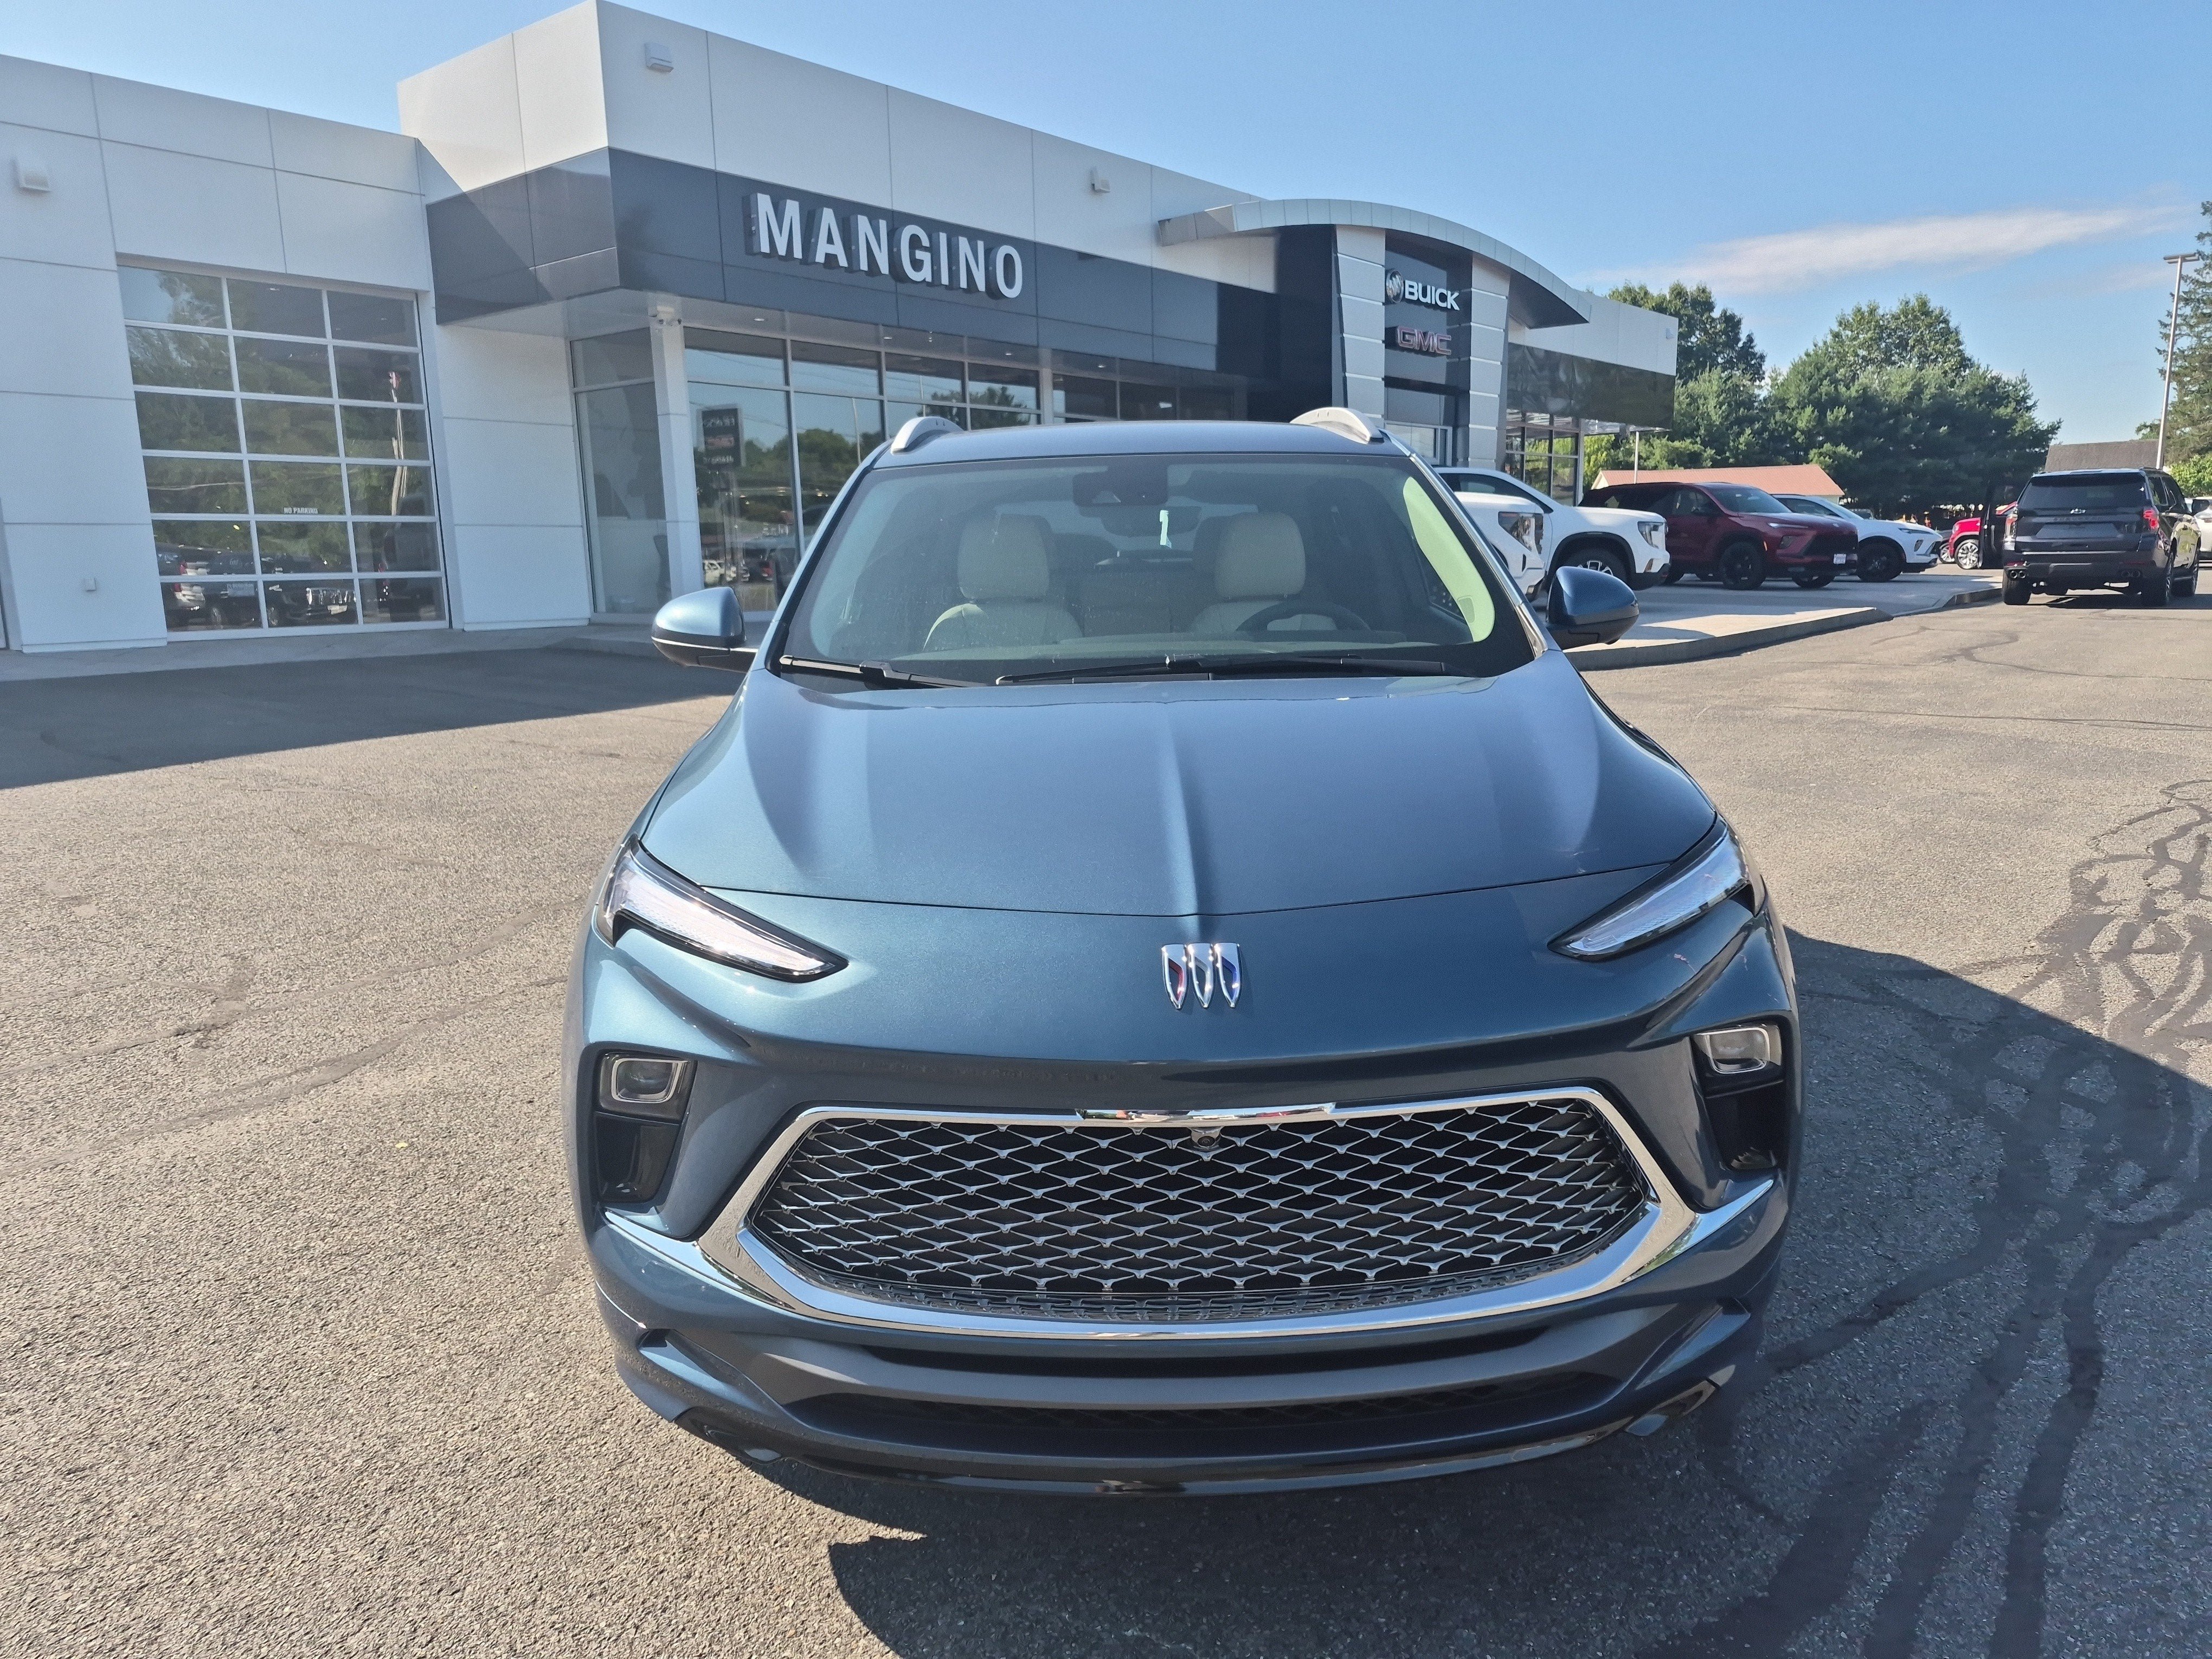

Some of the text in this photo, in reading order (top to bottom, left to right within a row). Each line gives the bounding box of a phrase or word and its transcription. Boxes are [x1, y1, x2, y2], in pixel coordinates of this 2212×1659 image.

[754, 192, 1023, 298] MANGINO
[1405, 280, 1460, 311] BUICK
[1397, 326, 1452, 355] GMC
